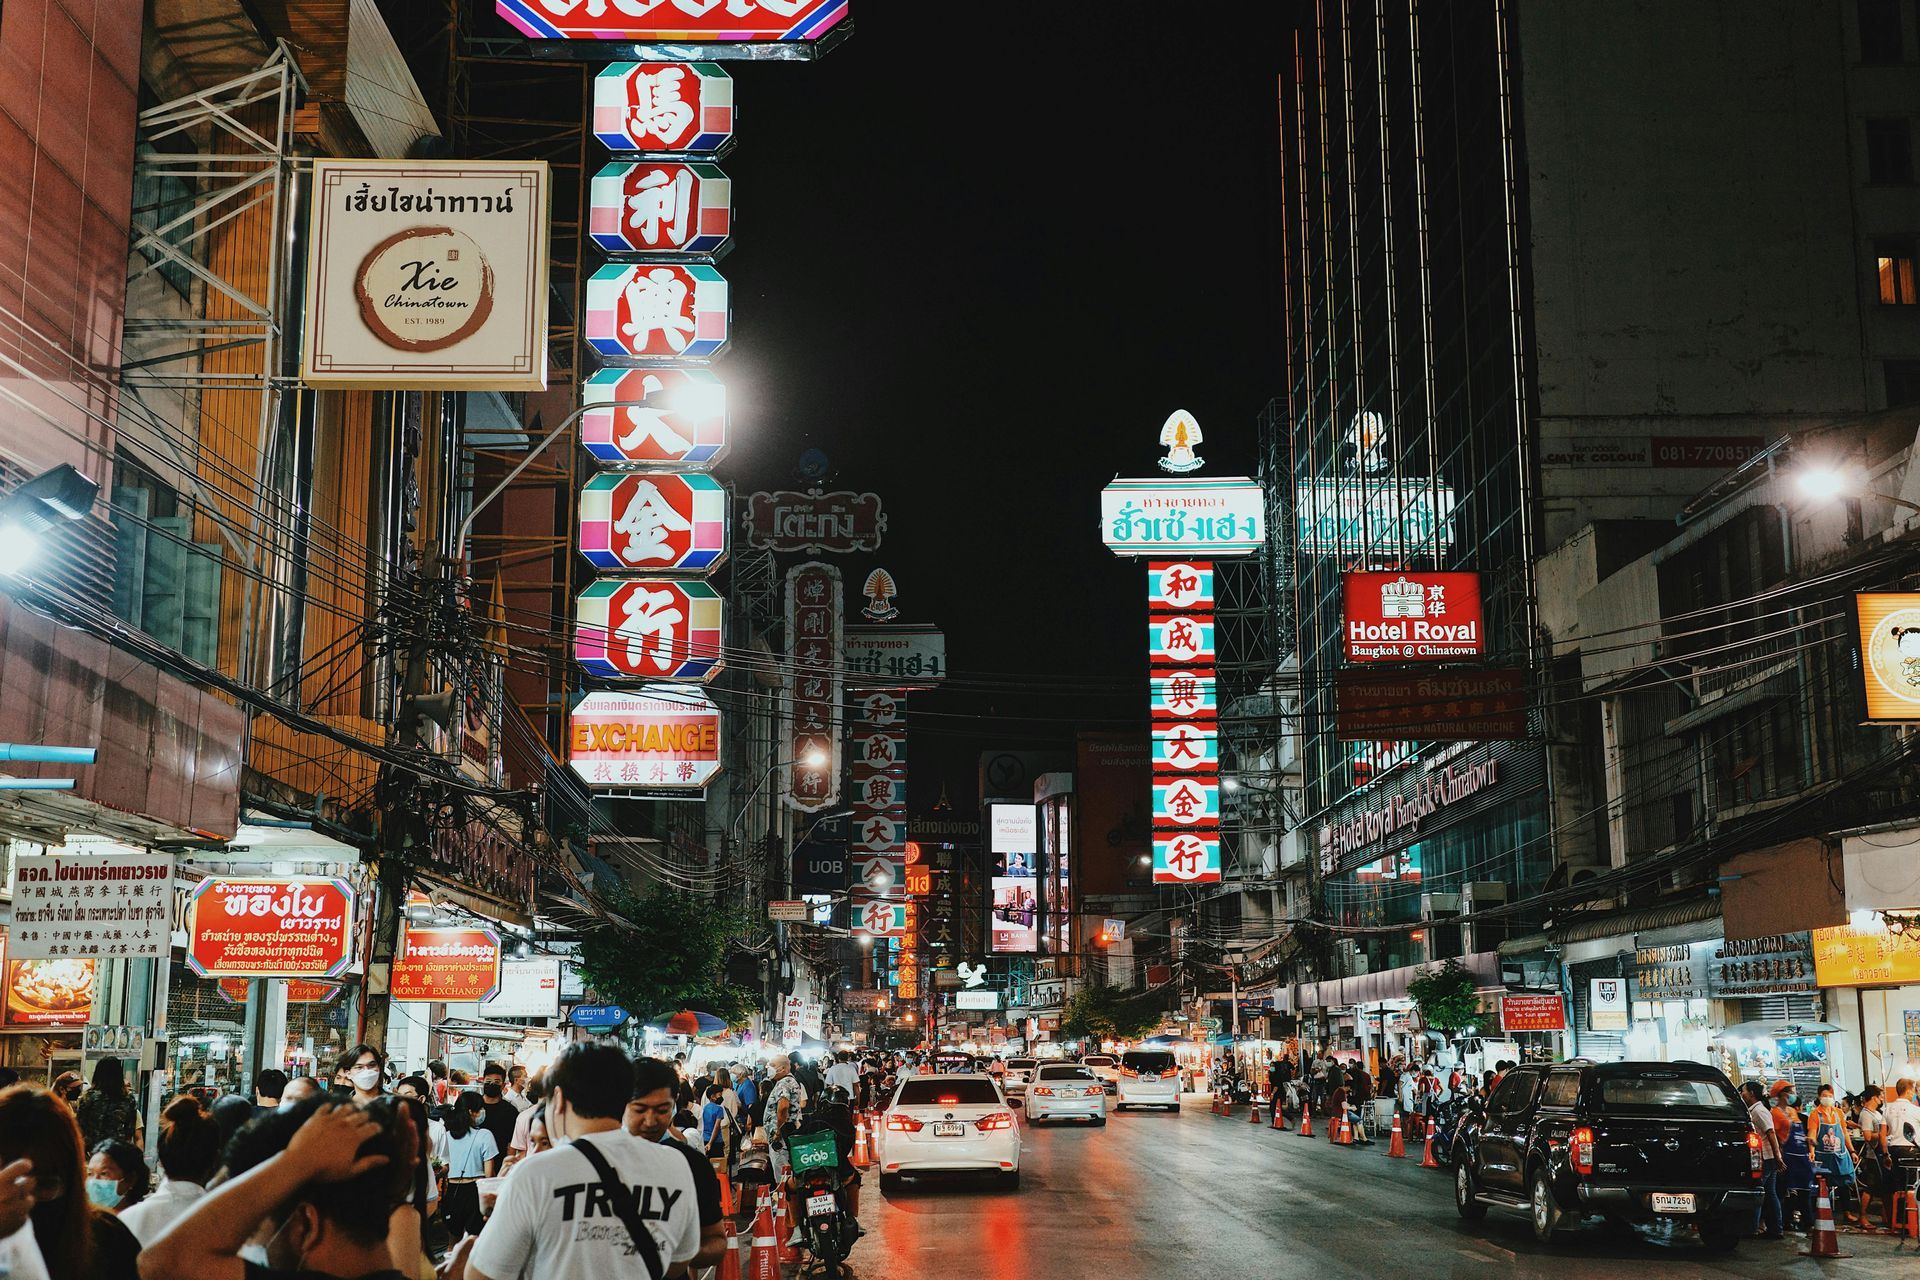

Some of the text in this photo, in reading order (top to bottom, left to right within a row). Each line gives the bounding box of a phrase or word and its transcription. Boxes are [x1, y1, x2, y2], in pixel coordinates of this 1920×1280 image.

[400, 261, 459, 292] Xie
[384, 294, 468, 308] Chinatown
[1427, 585, 1446, 618] 京华
[1350, 621, 1476, 641] Hotel Royal
[1351, 645, 1400, 658] Bangkok
[1417, 645, 1477, 655] Chinatown
[1166, 569, 1204, 874] 和成興大金行
[572, 723, 716, 753] EXCHANGE
[594, 761, 697, 782] 找換外幣
[1340, 812, 1365, 854] Hotel
[1366, 795, 1395, 845] Royal
[1395, 776, 1437, 832] Bangkok
[1440, 758, 1499, 807] Chinatown
[809, 860, 843, 874] UOB
[393, 987, 486, 996] MONEY EXCHANGE
[614, 1009, 621, 1019] 9
[800, 1149, 828, 1164] Grab
[554, 1182, 682, 1221] TRLY
[1673, 1196, 1691, 1205] 7250
